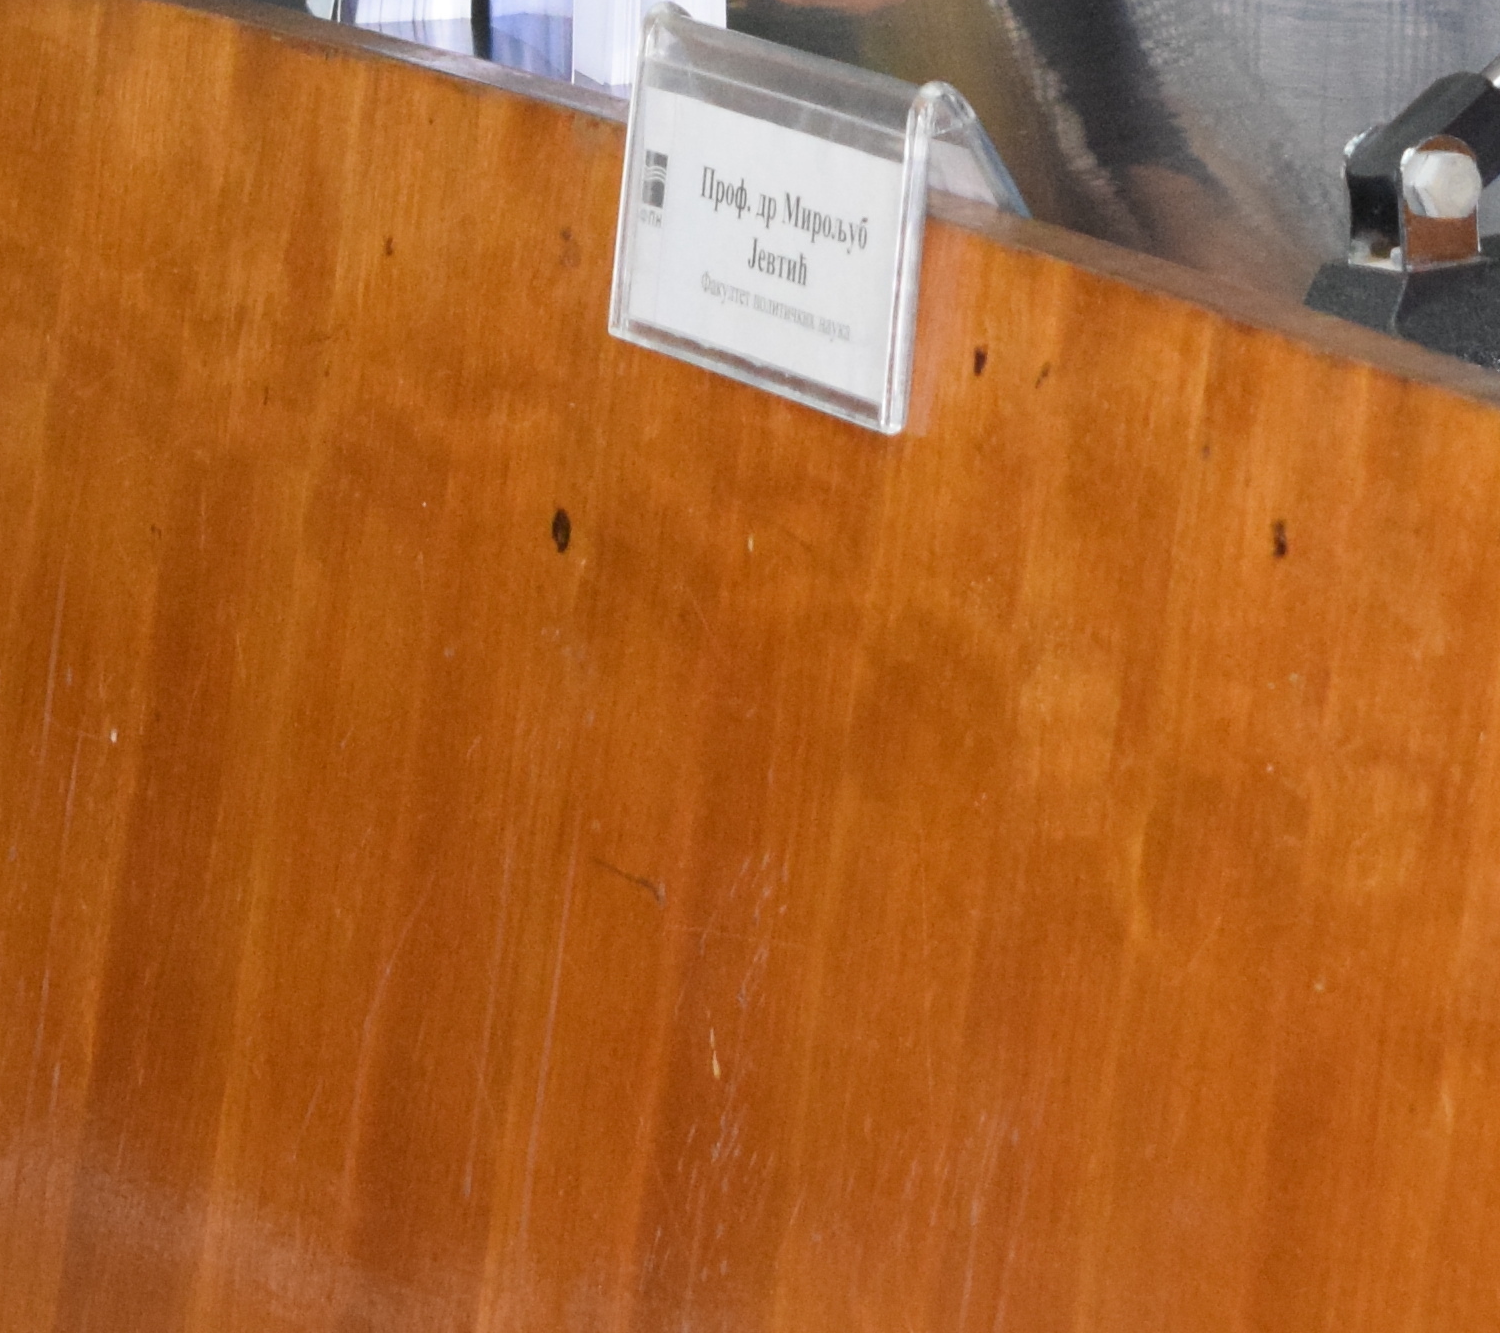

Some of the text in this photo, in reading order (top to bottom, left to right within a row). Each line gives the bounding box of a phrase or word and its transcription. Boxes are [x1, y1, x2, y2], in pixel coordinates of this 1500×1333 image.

[701, 166, 869, 254] Проф. др Мирољуб
[748, 237, 807, 286] Јевтић
[701, 271, 750, 307] Факултет
